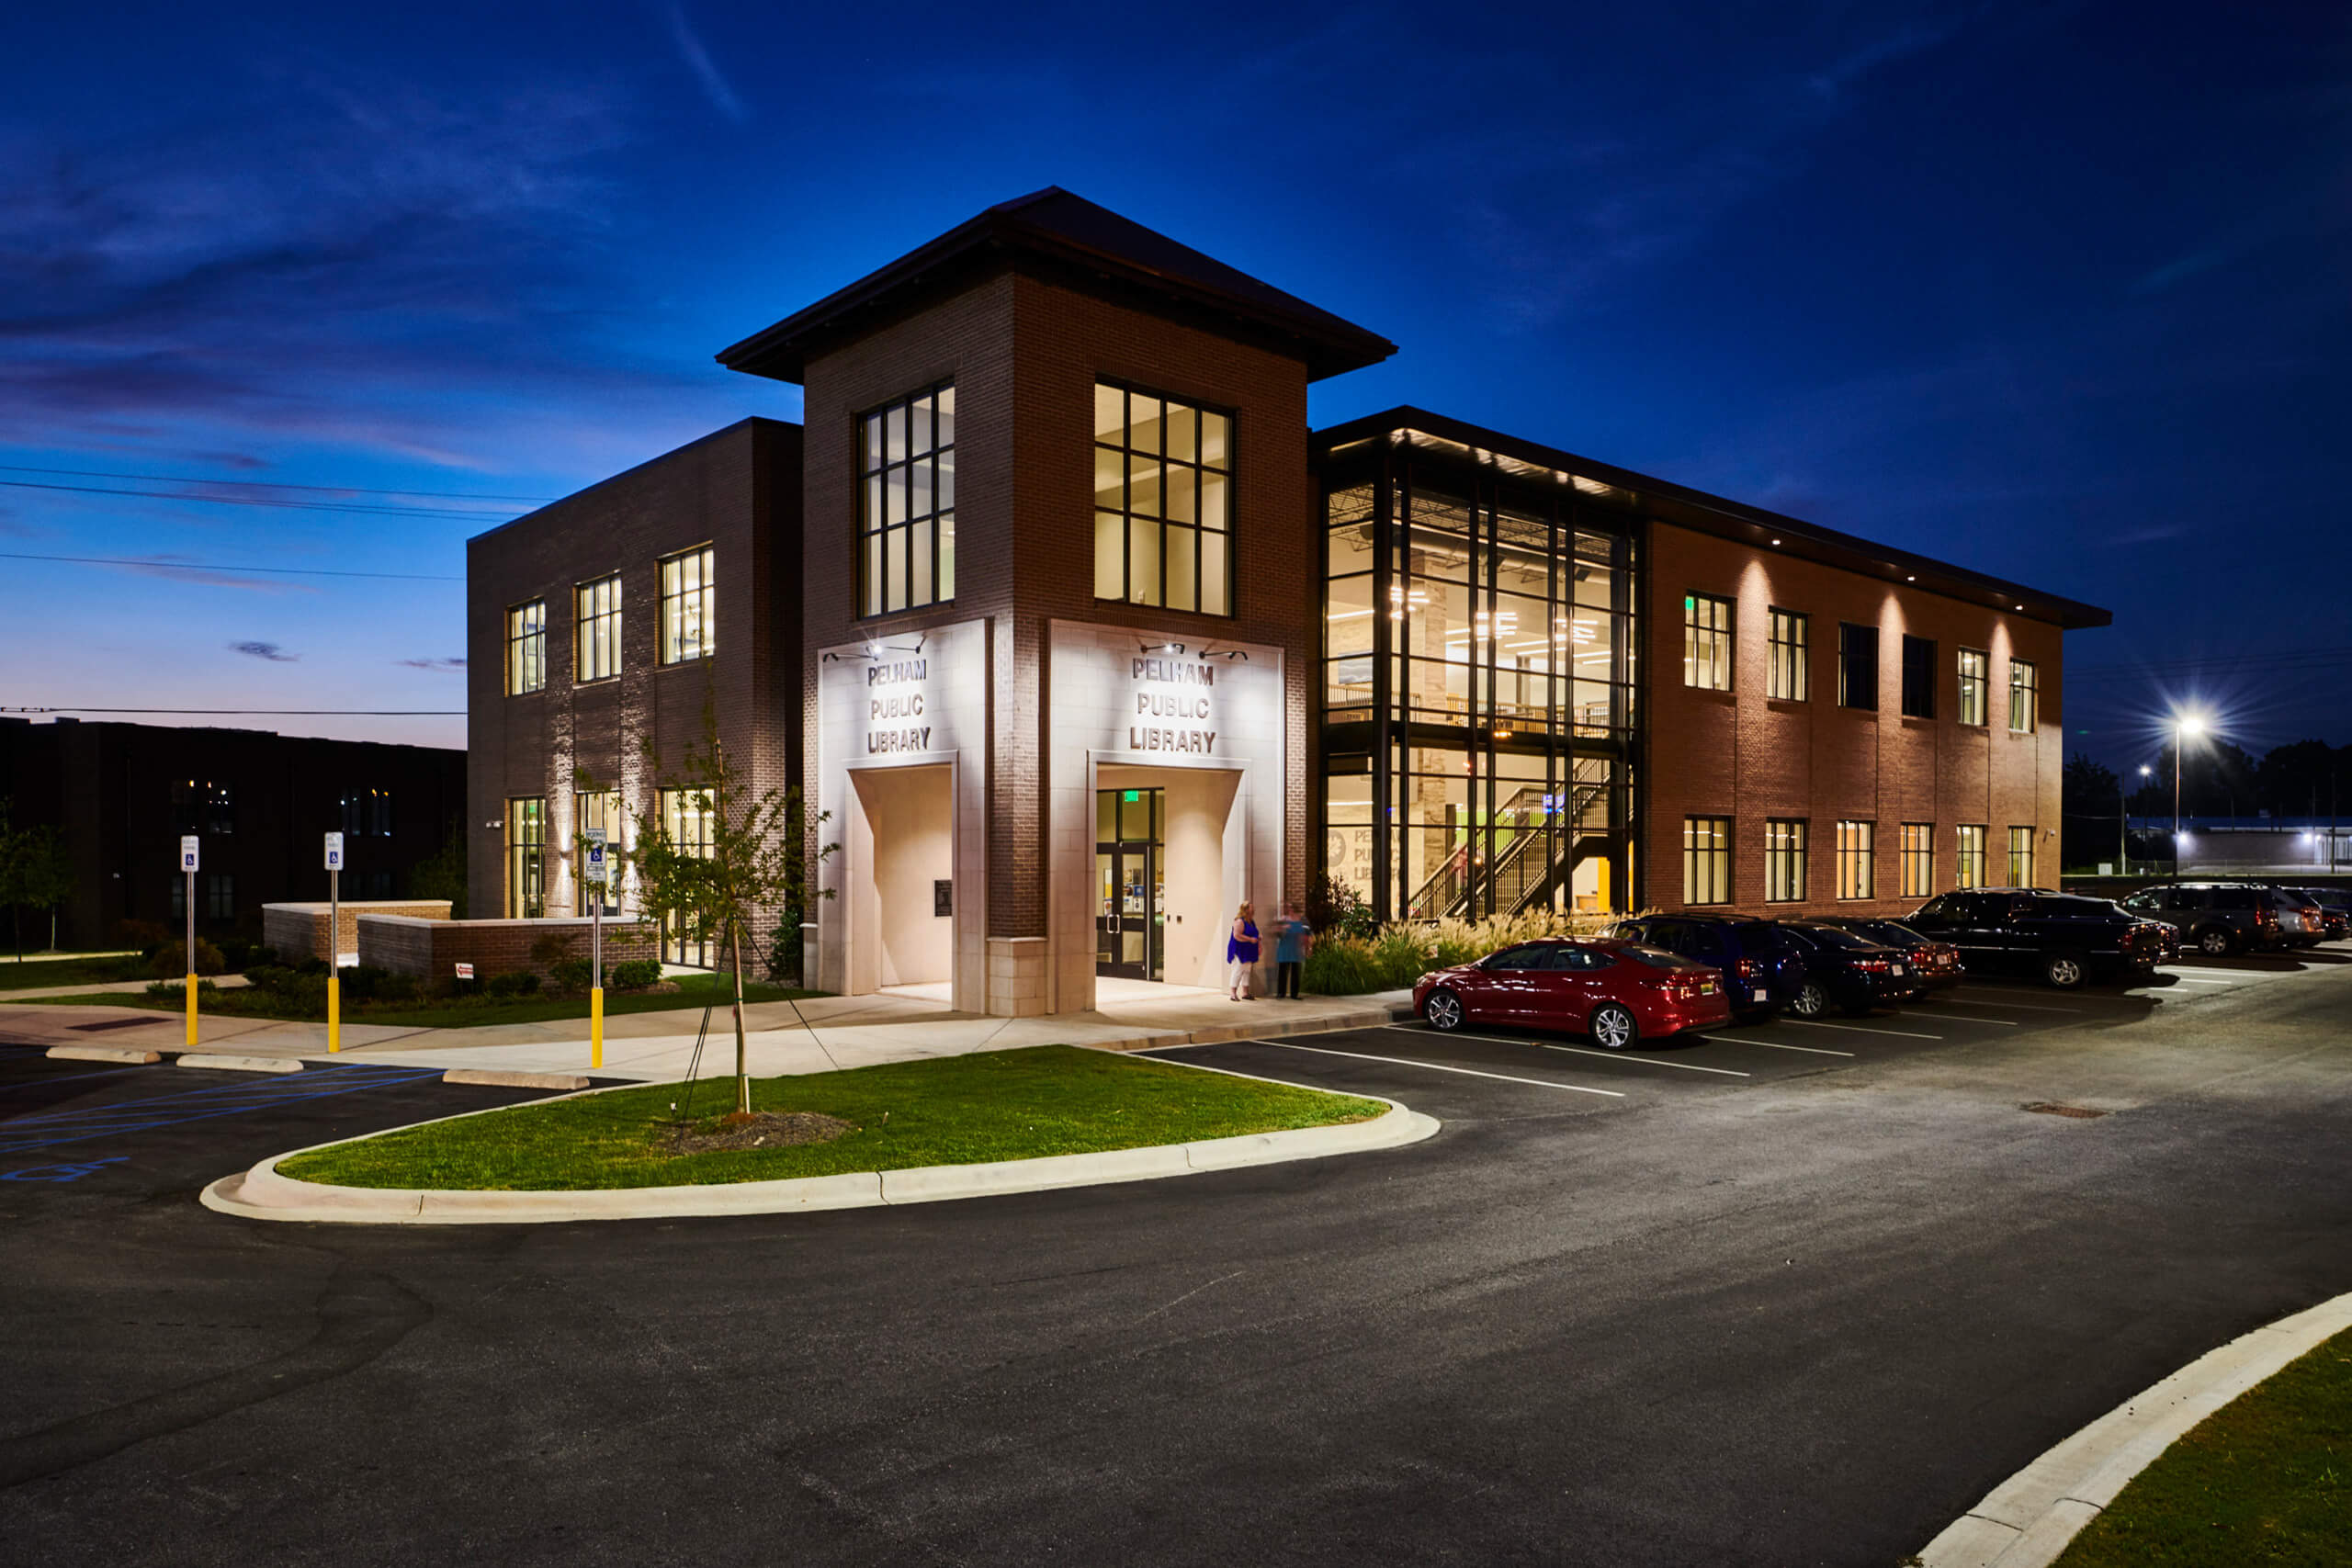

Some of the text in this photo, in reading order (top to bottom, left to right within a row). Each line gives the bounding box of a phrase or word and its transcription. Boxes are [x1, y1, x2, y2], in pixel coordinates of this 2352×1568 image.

[868, 659, 927, 687] PELHAM
[1133, 658, 1214, 686] PELHAM
[871, 694, 923, 720] PUBLIC
[1137, 693, 1209, 718] PUBLIC
[868, 727, 931, 753] LIBRARY
[1130, 727, 1216, 753] LIBRARY
